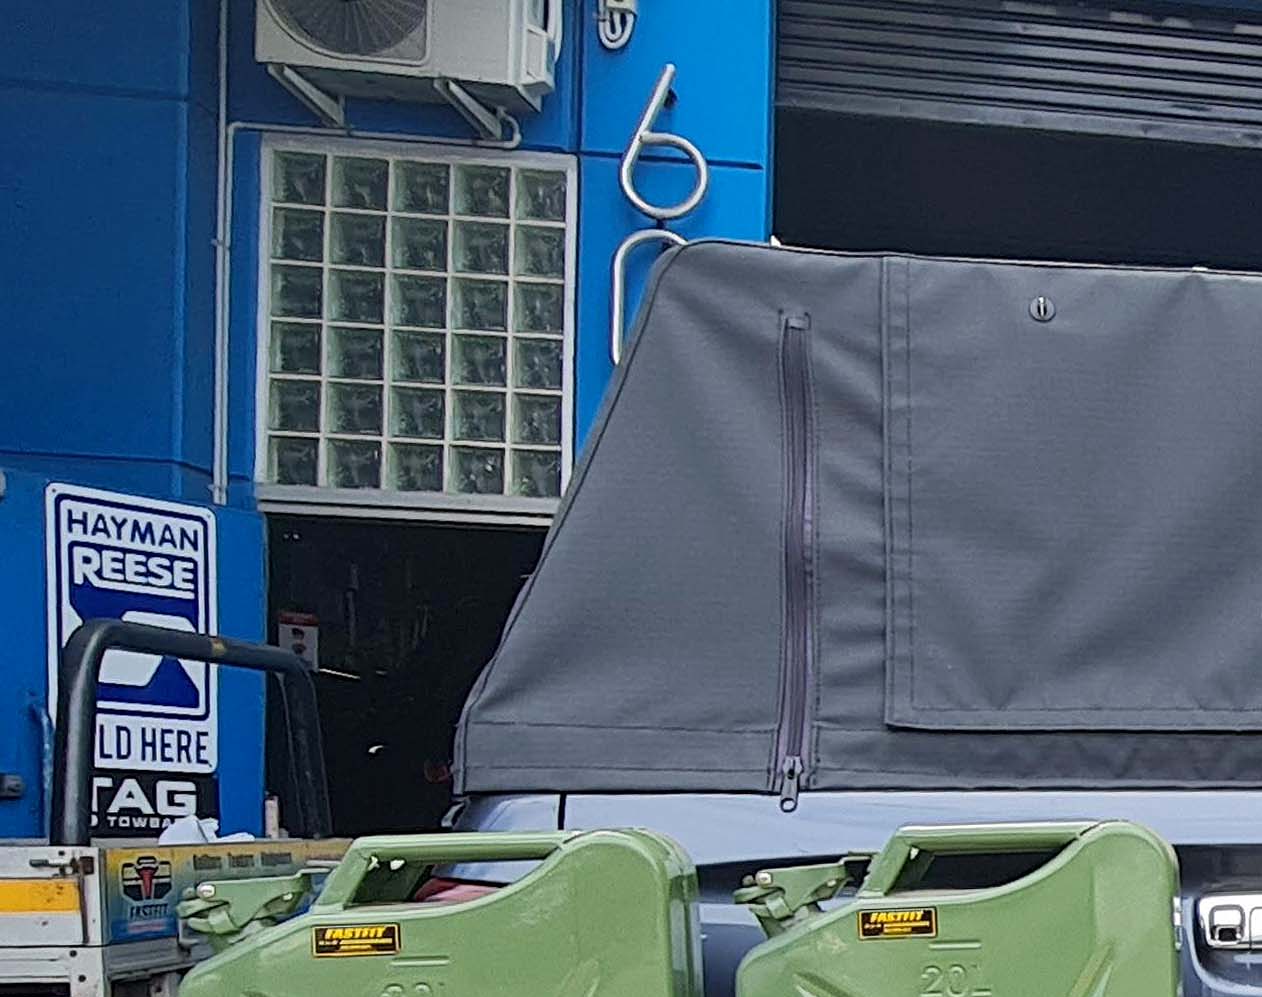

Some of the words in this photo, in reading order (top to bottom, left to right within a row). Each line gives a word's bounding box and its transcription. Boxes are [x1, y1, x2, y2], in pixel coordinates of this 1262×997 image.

[67, 509, 199, 552] HAYMAN
[73, 546, 195, 593] REESE
[141, 727, 209, 765] HERE
